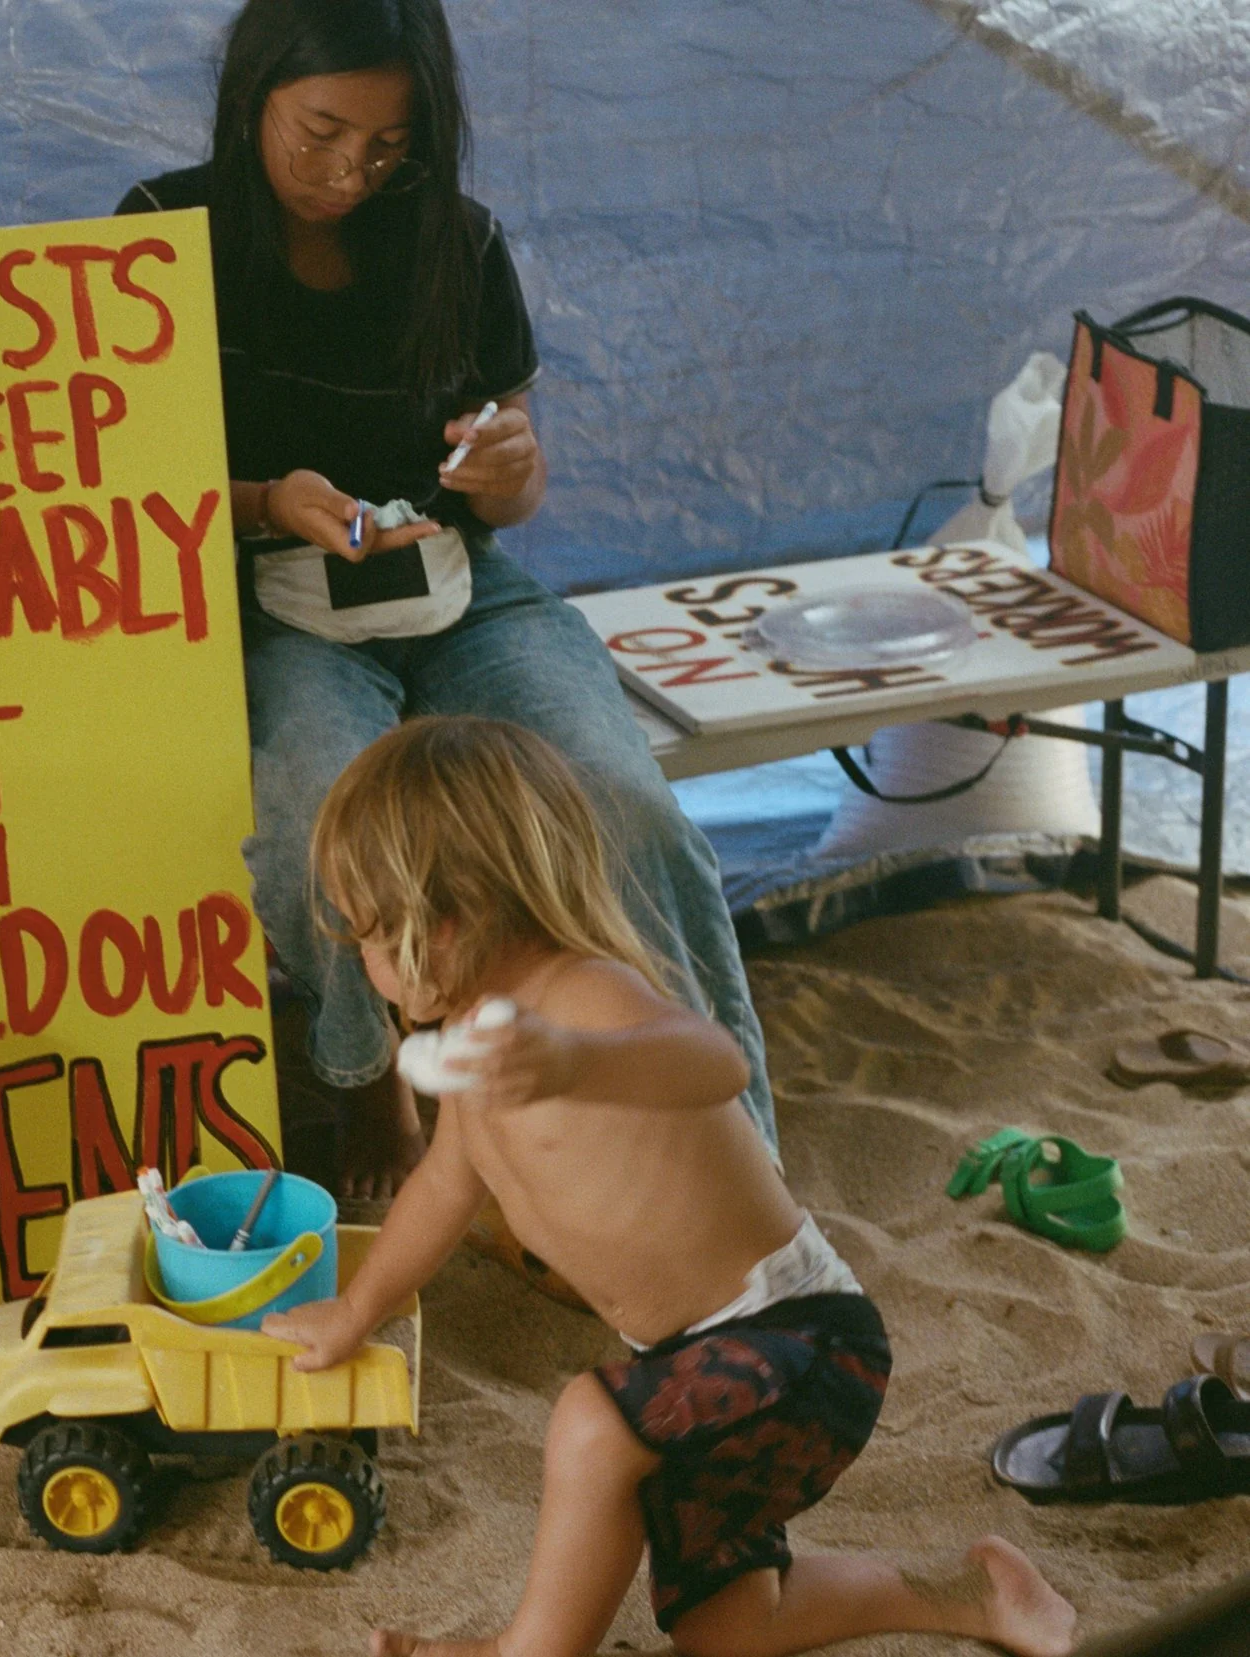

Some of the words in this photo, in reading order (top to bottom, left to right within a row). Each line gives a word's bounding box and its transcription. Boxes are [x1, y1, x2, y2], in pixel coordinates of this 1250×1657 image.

[606, 627, 761, 688] NO
[890, 546, 1159, 668] WORKERS
[78, 891, 263, 1016] OUR
